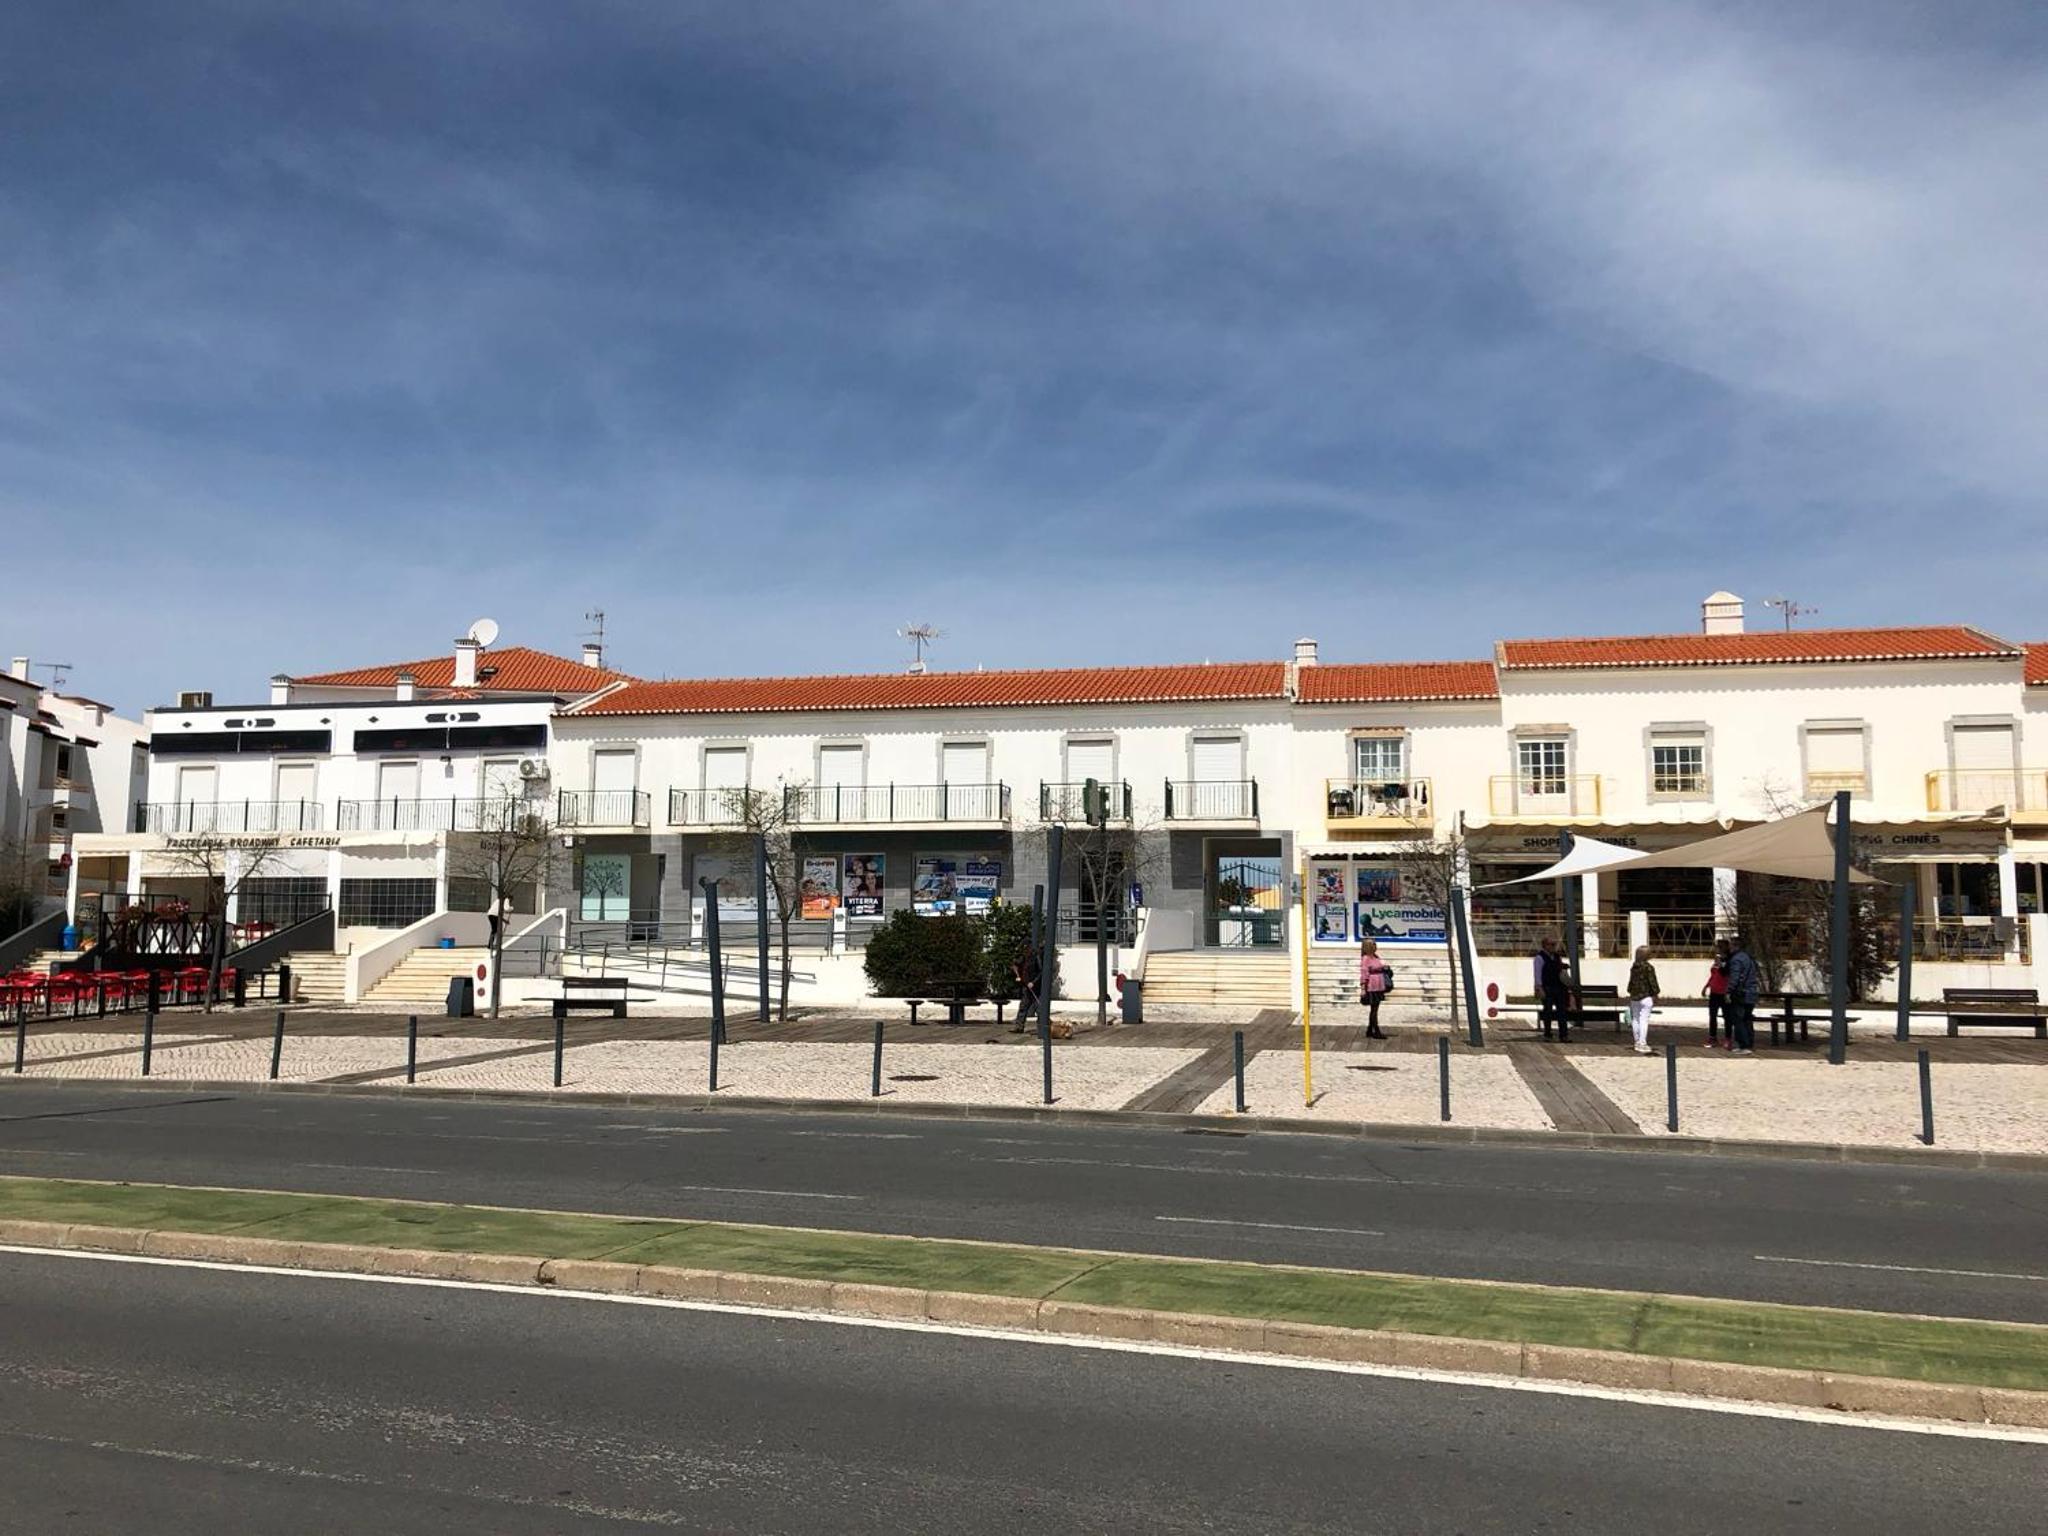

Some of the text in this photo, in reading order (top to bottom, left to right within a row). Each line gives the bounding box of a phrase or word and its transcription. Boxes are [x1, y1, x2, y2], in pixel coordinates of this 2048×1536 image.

[229, 837, 281, 848] BROADWAY
[290, 836, 341, 846] CAFETARIA
[1892, 832, 1941, 845] CHINÊS
[848, 897, 879, 905] VITERRA
[1371, 907, 1445, 920] Lycamobile
